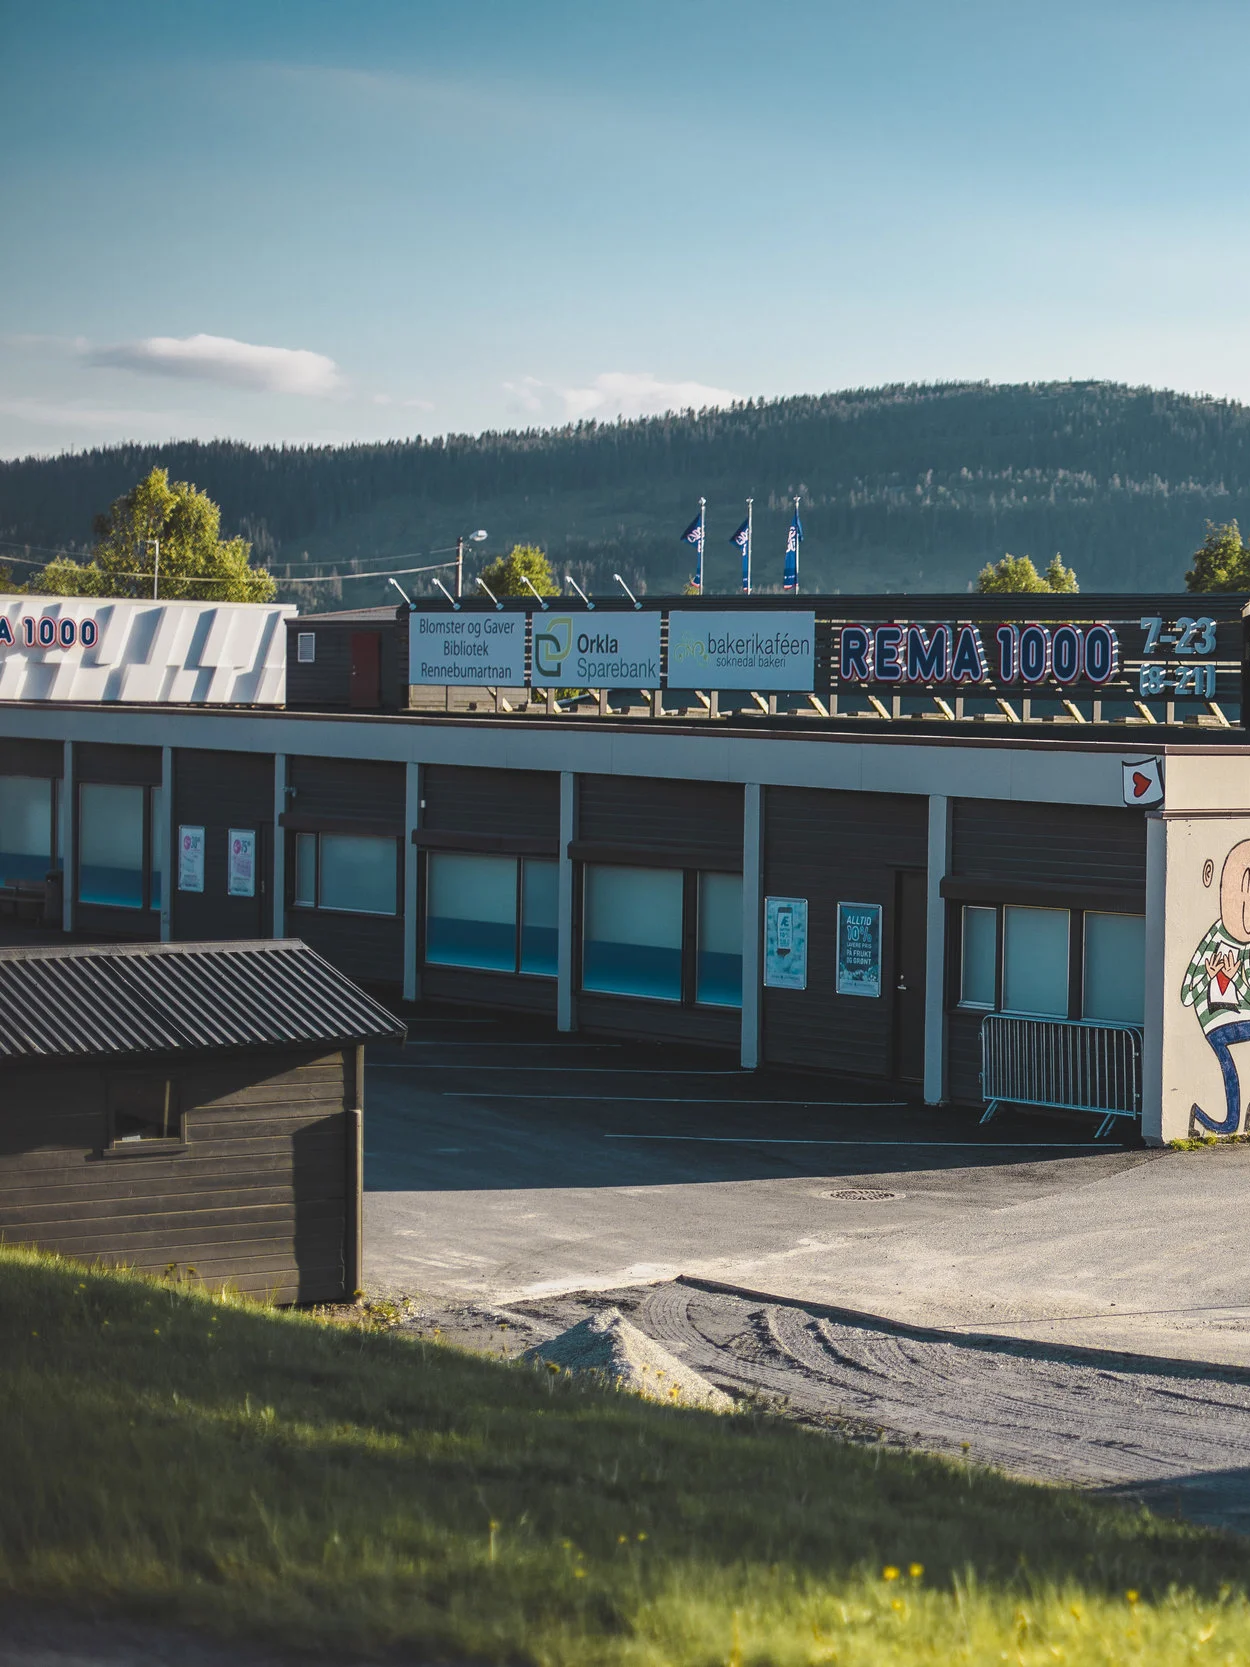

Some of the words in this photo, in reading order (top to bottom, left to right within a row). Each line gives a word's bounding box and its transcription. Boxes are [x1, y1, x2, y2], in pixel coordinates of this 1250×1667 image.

[22, 616, 98, 648] 1000
[419, 618, 465, 634] Blomster
[468, 621, 481, 638] og
[484, 618, 515, 634] Gaver
[1140, 616, 1217, 654] 7-23
[443, 640, 489, 656] Bibliotek
[577, 633, 618, 654] Orkla
[708, 632, 810, 655] bakerikaféen
[716, 655, 756, 668] soknedal
[759, 655, 786, 668] bakeri
[840, 624, 987, 683] REMA
[995, 624, 1118, 684] 1000
[421, 662, 512, 679] Rennebumartnan
[577, 657, 656, 682] Sparebank
[1139, 663, 1216, 698] (8-21)
[847, 916, 872, 926] ALLTID
[847, 925, 873, 943] 10%
[853, 950, 872, 958] FRUKT
[853, 957, 872, 965] GRØNT
